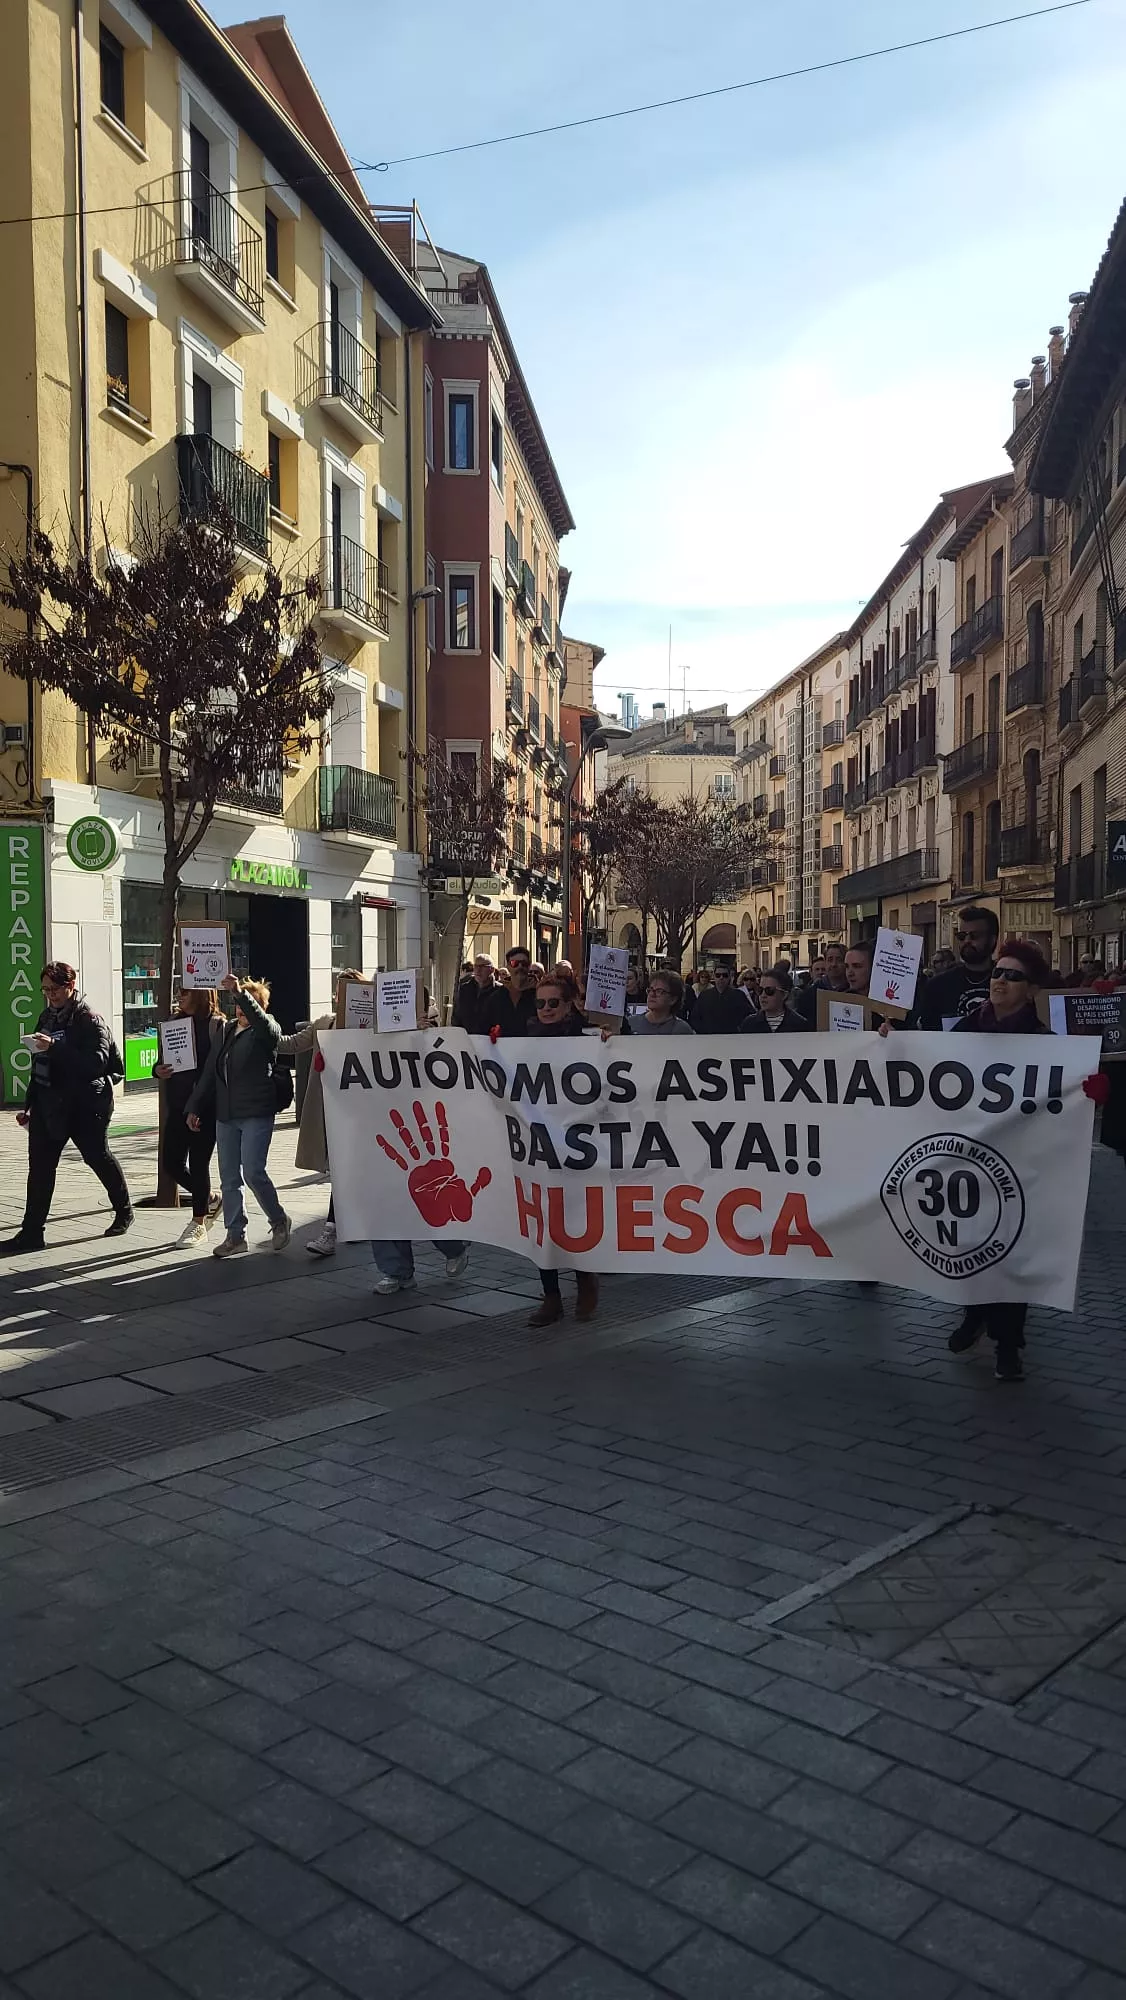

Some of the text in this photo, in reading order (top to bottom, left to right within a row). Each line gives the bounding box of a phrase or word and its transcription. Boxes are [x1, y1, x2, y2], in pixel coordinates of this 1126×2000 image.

[77, 822, 104, 832] PLAZA
[210, 960, 218, 968] 30
[1108, 1030, 1120, 1040] 30
[340, 1037, 1063, 1115] AUTÓNOMOS ASFIXIADOS!!
[505, 1115, 822, 1177] BASTA YA!!
[886, 1138, 1016, 1202] MANIFESTACIÓN NACIONAL
[915, 1169, 980, 1218] 30
[514, 1176, 834, 1253] HUESCA
[936, 1220, 958, 1247] N
[904, 1229, 1006, 1274] DE AUTÓNOMOS
